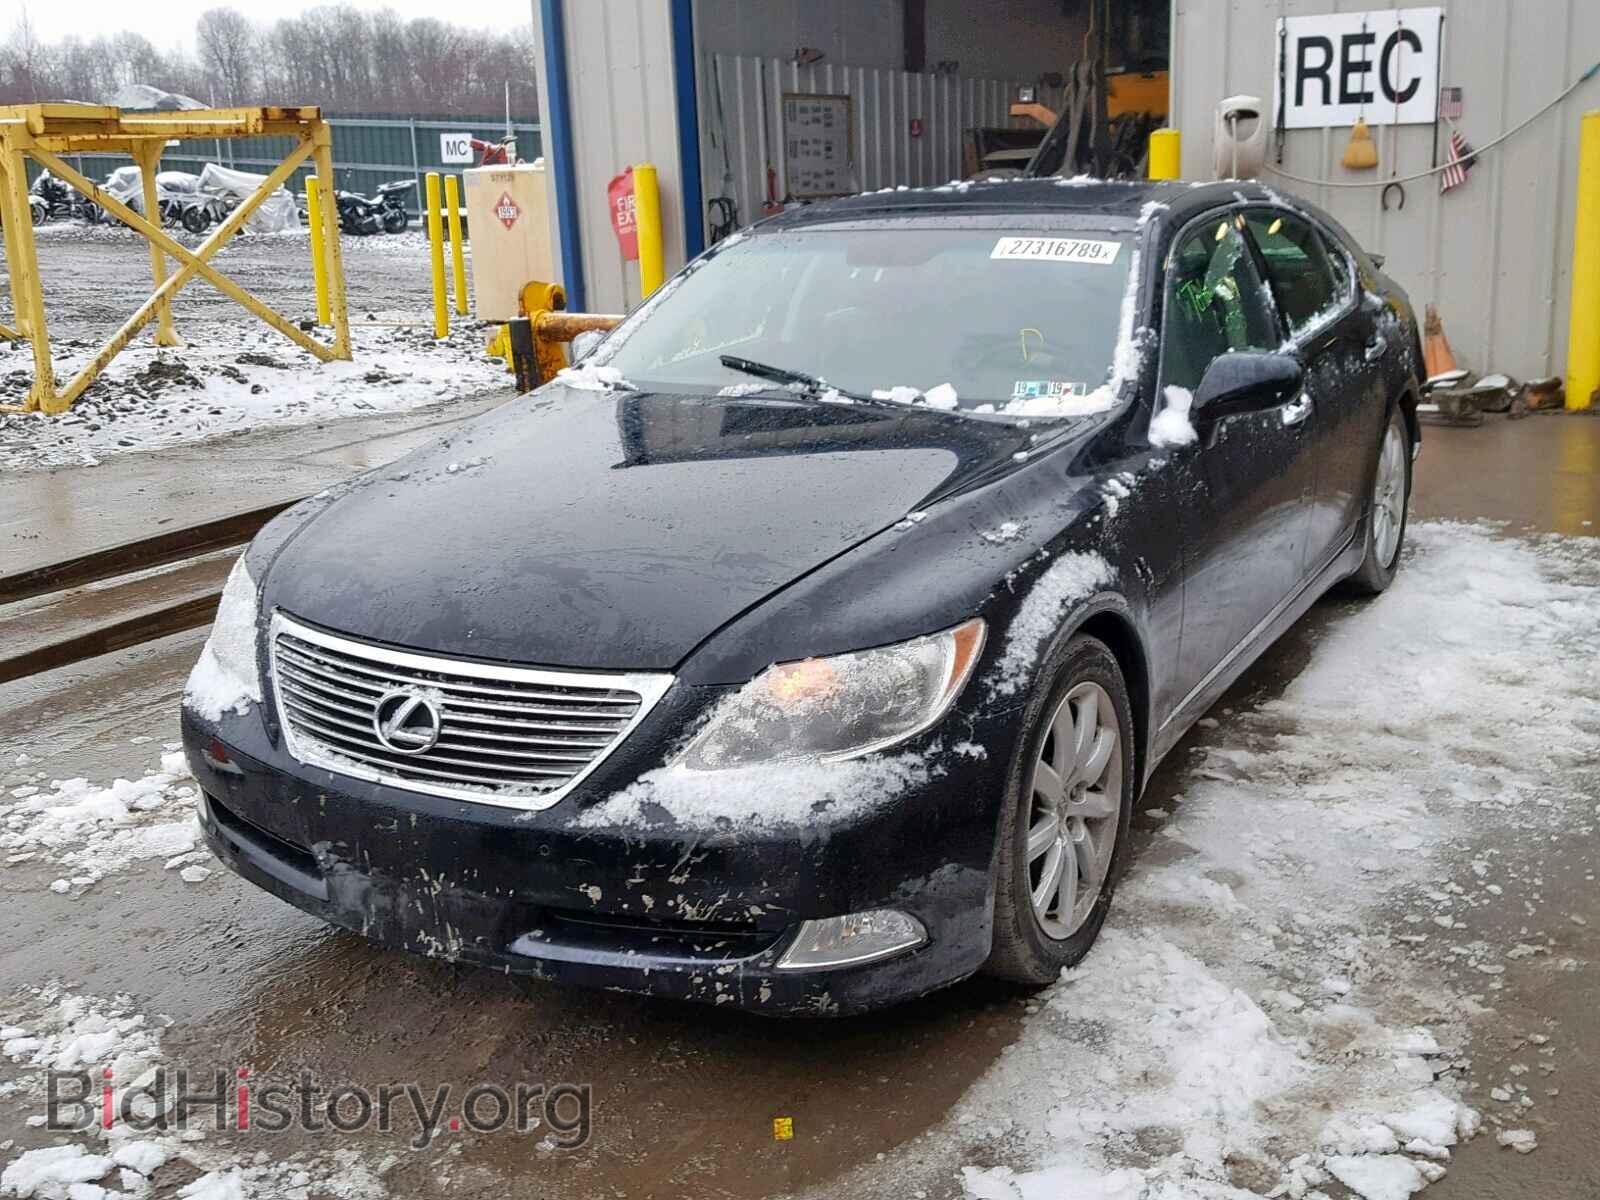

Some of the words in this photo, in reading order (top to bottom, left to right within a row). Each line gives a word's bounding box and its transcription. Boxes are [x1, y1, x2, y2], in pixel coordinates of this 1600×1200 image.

[1294, 28, 1423, 107] REC
[445, 140, 469, 157] MC
[1008, 239, 1103, 258] 27316789
